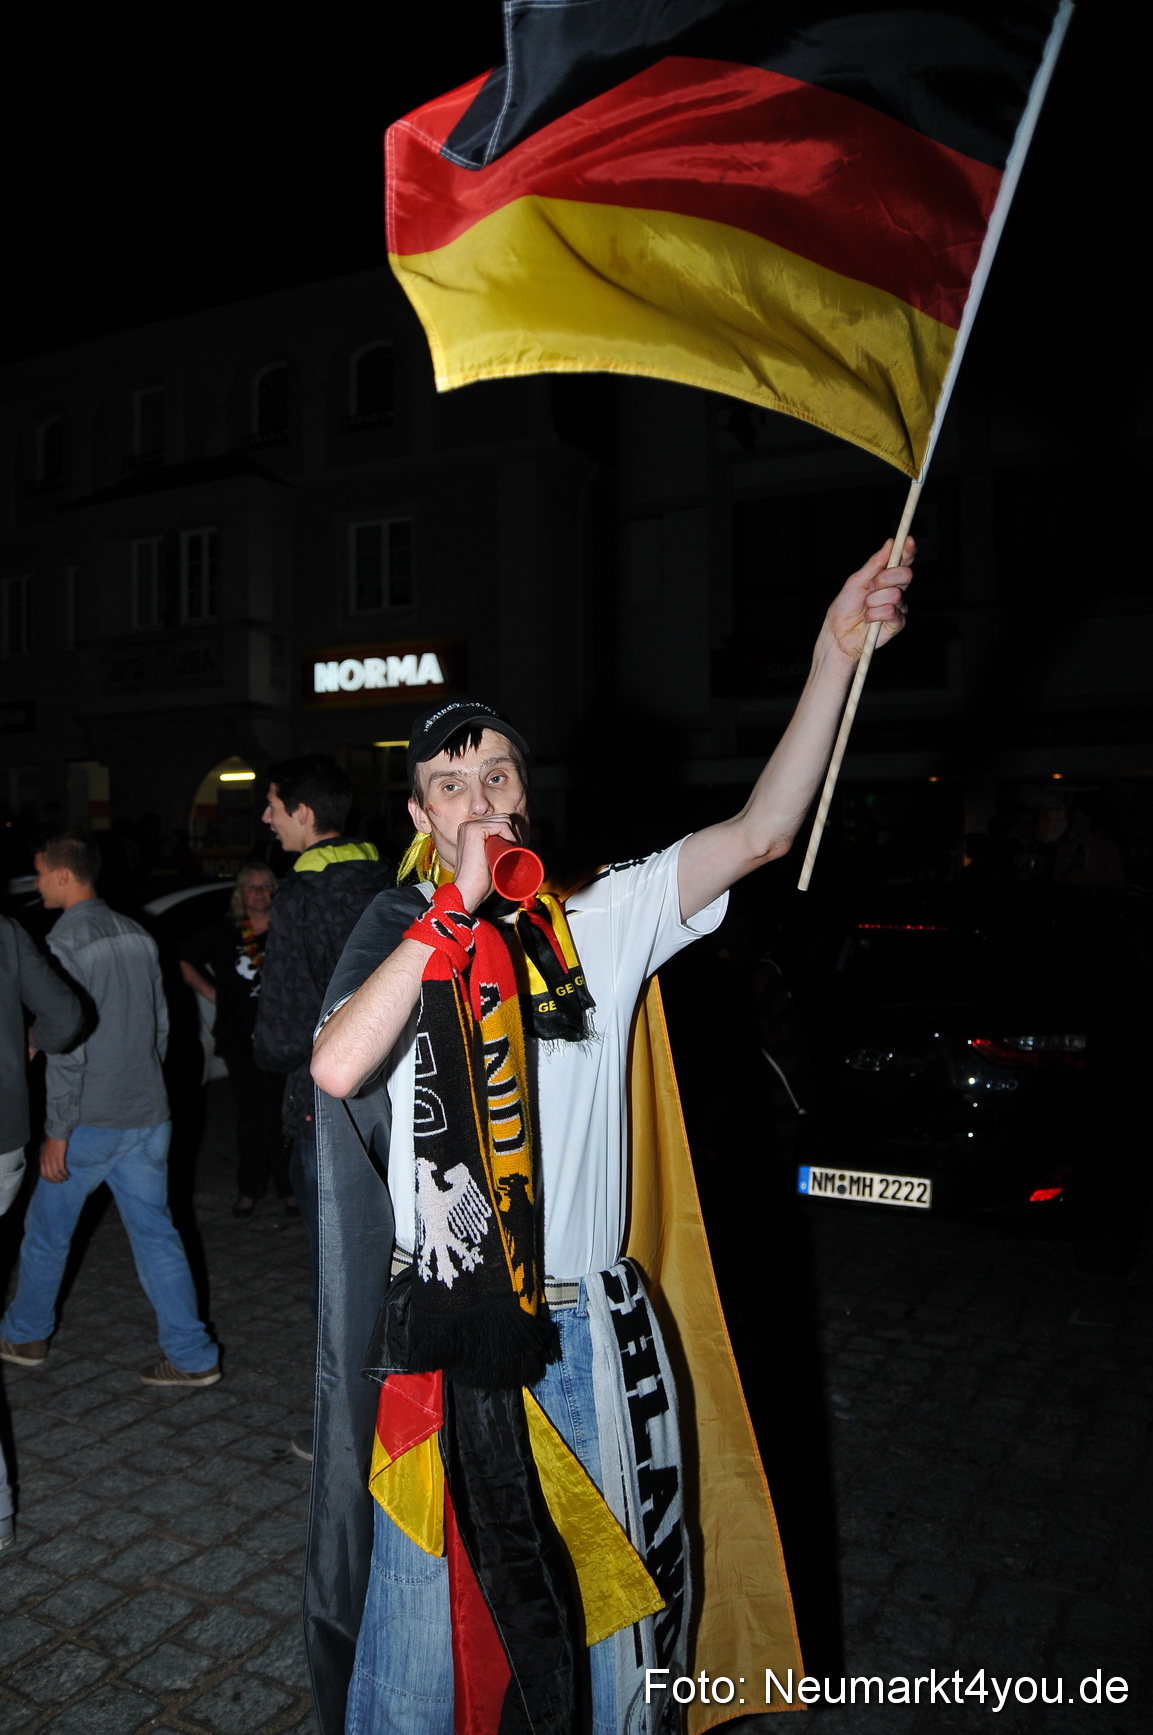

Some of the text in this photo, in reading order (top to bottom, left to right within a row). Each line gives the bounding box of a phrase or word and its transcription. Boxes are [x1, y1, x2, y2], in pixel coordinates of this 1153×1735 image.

[314, 652, 444, 693] NORMA
[555, 983, 574, 997] GE
[538, 1000, 557, 1013] GE
[812, 1171, 927, 1203] NM MH 2222
